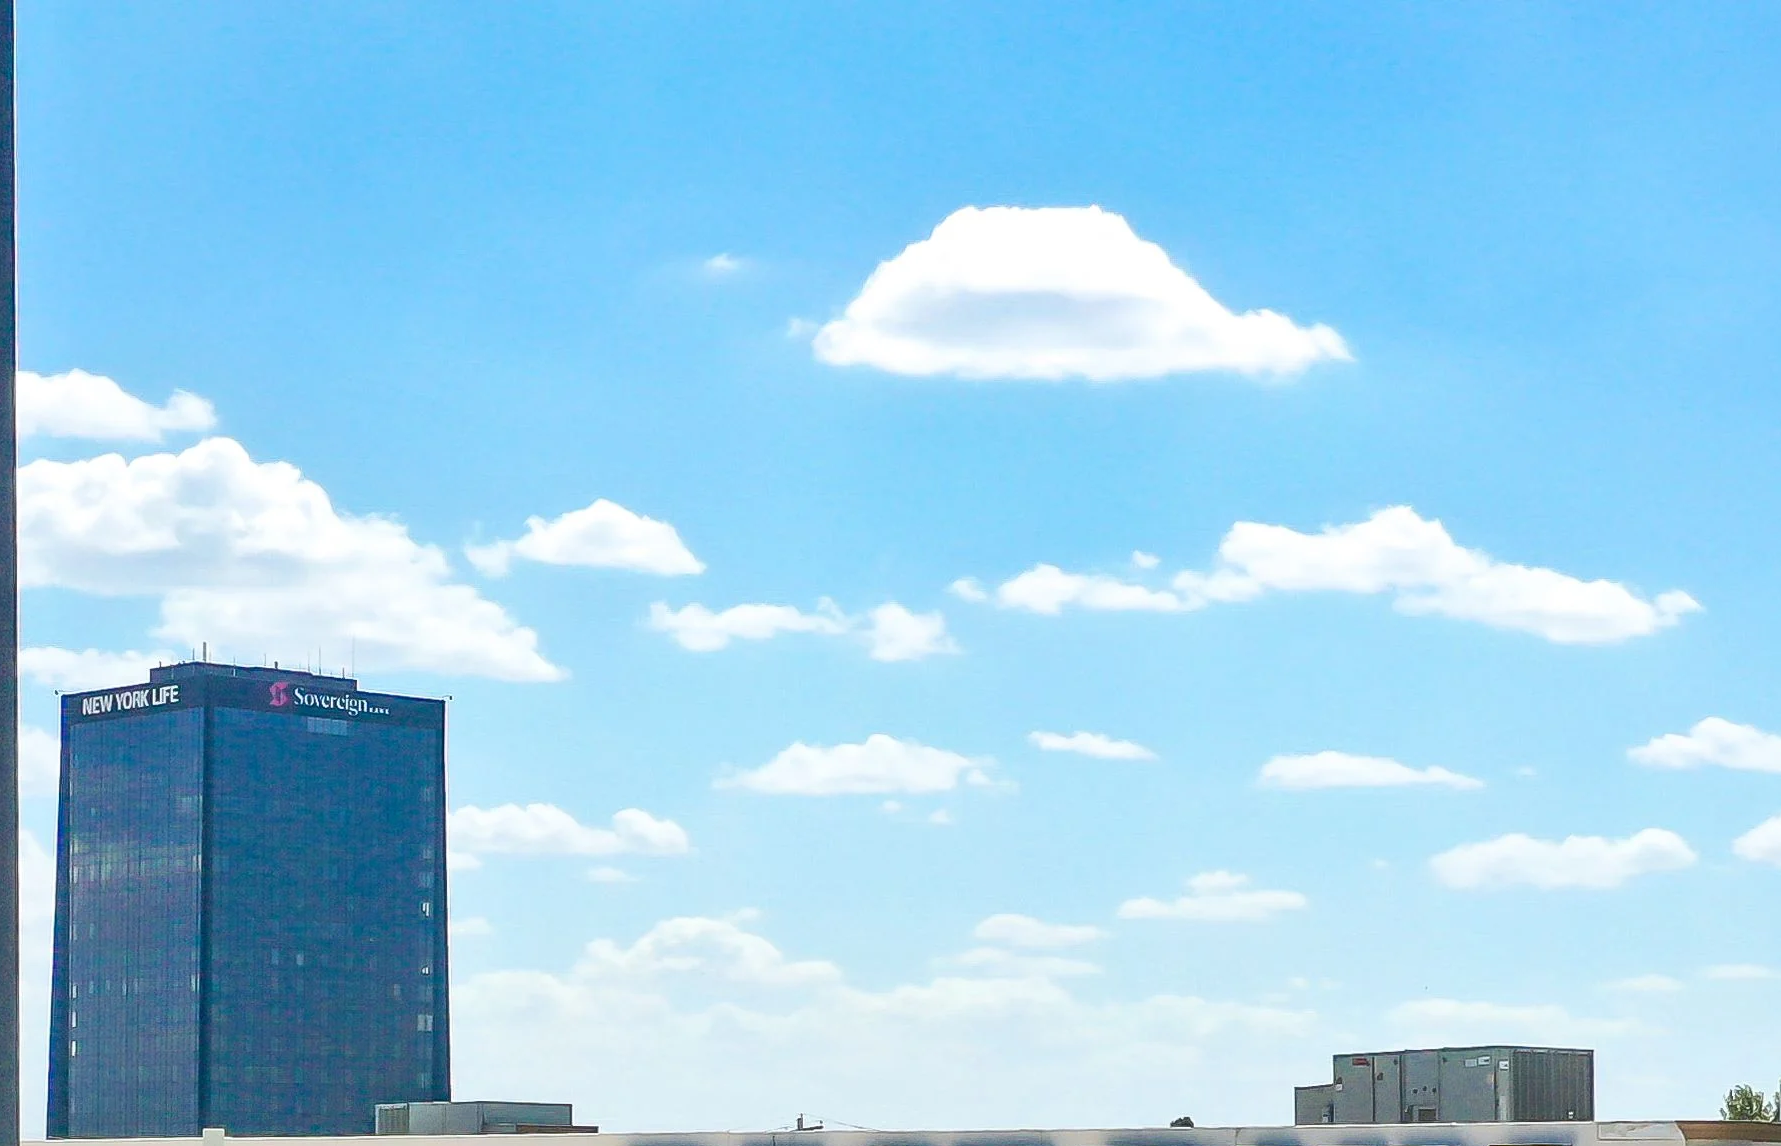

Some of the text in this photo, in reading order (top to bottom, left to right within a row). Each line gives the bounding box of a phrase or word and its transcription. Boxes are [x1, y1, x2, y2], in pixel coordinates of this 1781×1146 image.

[82, 685, 180, 716] NEW YORK LIFE
[293, 686, 368, 717] Sovereign
